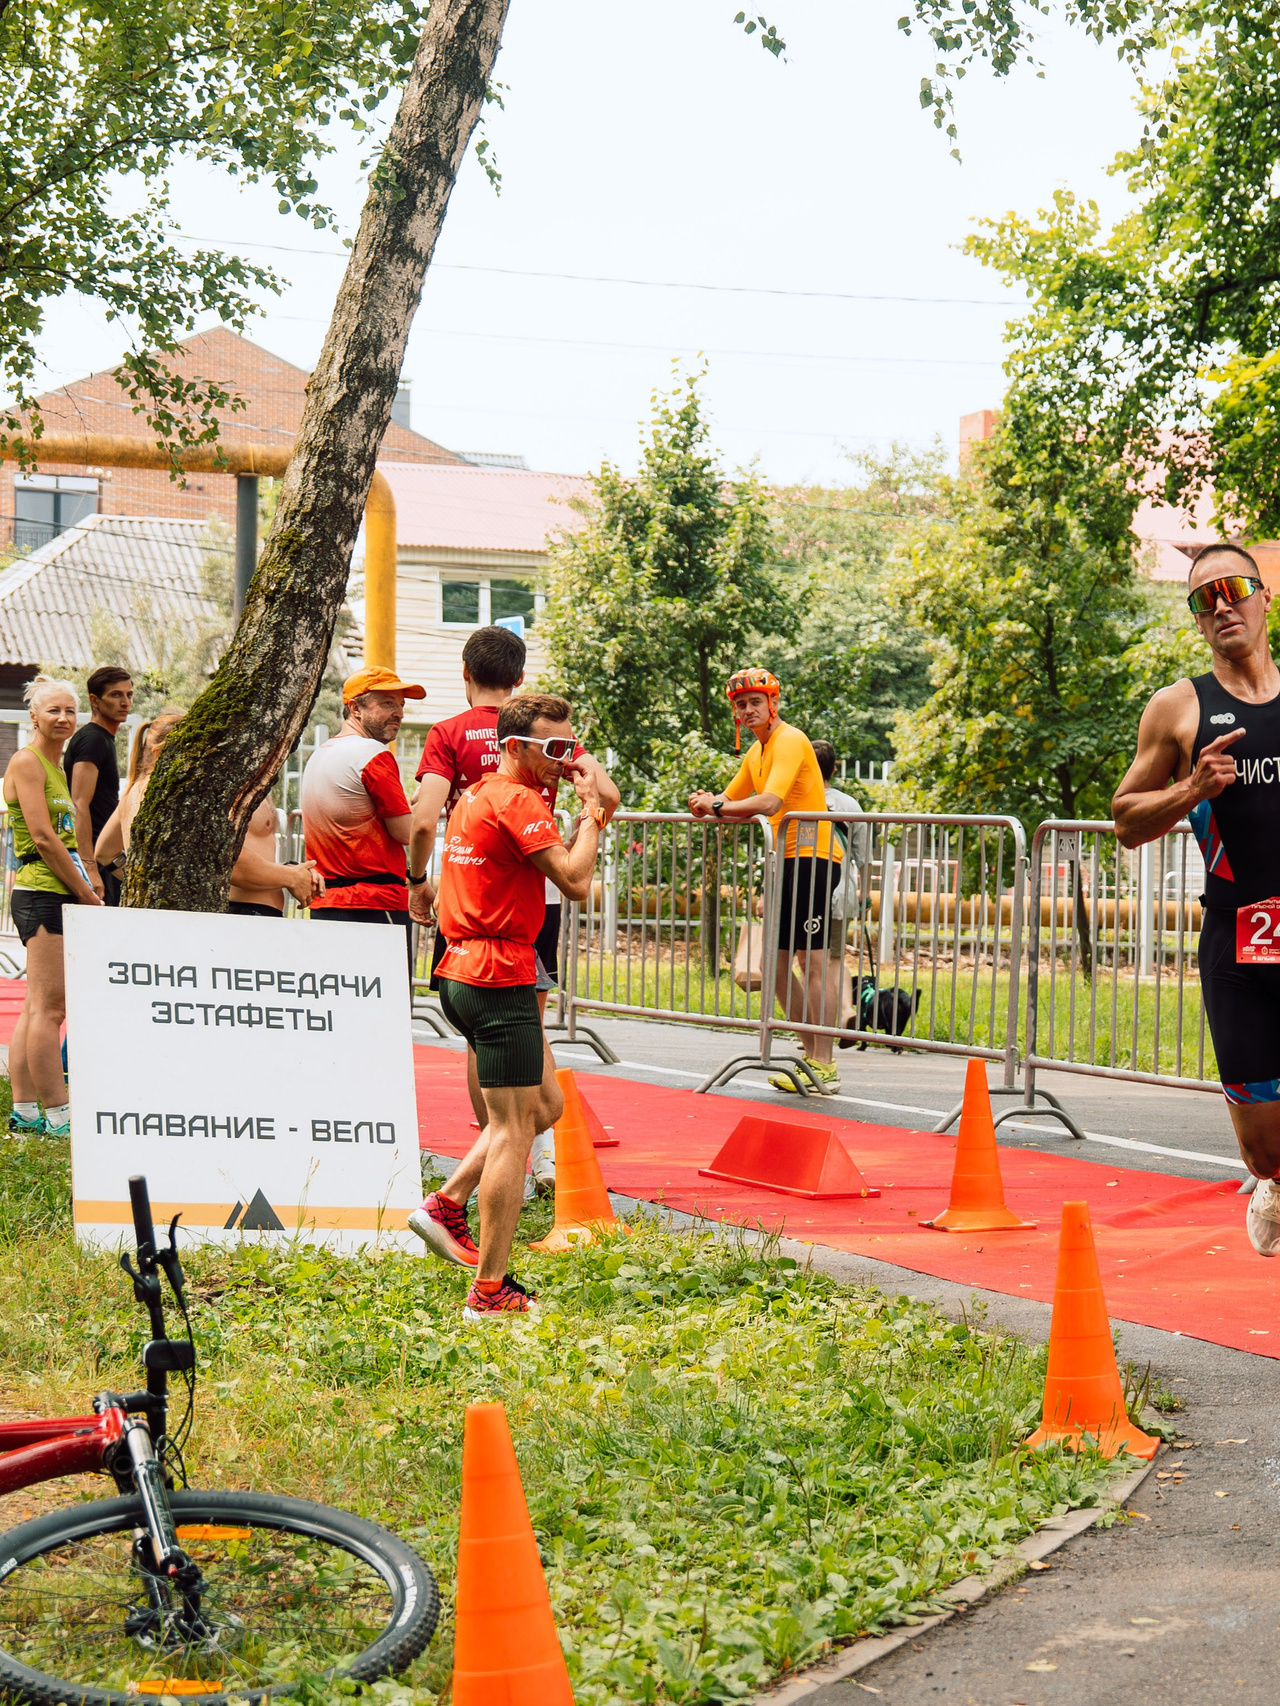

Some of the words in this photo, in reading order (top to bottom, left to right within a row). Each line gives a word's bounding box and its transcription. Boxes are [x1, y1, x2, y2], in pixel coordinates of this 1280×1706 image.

[108, 961, 198, 988] ЗОНА
[211, 967, 382, 999] ПЕРЕДАЧИ
[151, 1001, 333, 1032] ЭСТАФЕТЫ
[96, 1111, 276, 1140] ПЛАВАНИЕ
[311, 1119, 396, 1145] ВЕЛО
